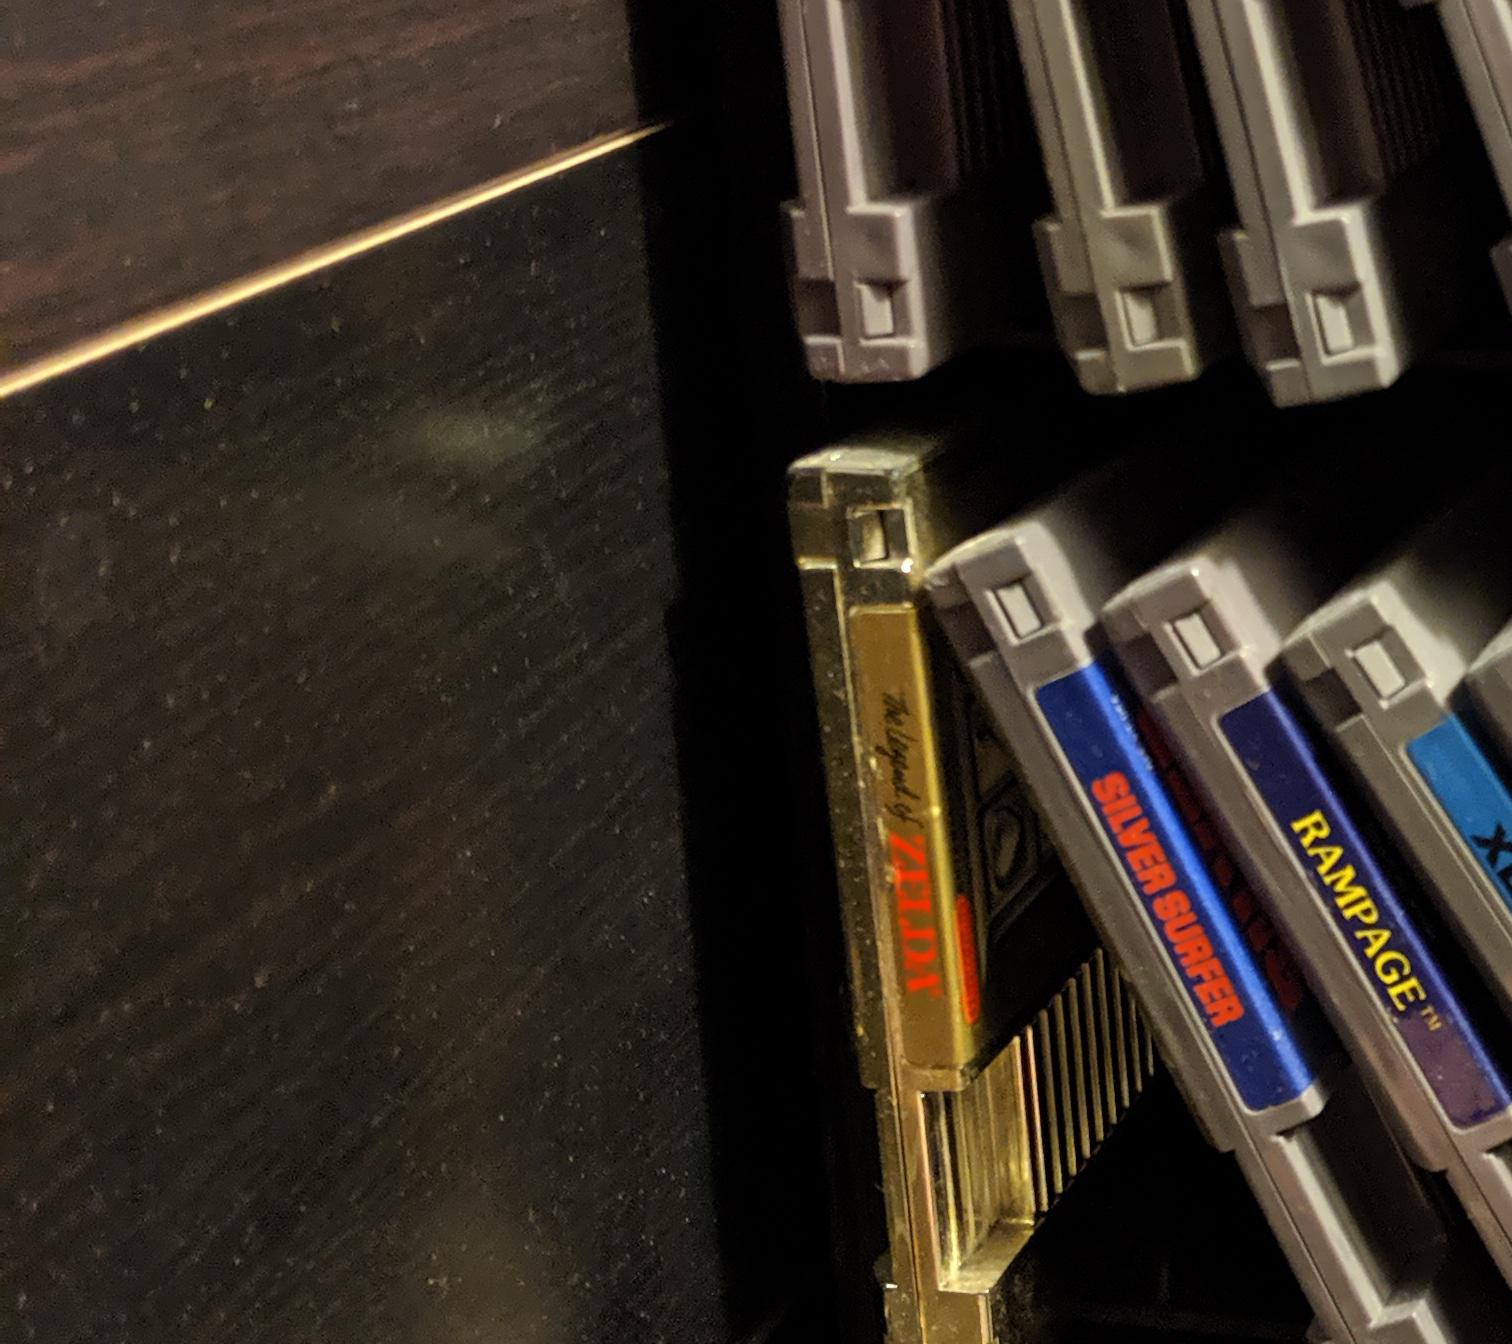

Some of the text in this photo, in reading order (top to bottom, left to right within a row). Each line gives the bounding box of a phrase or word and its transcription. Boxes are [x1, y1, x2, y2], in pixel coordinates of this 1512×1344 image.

[889, 833, 940, 993] ZELDA
[1092, 771, 1177, 895] SILVER
[1153, 892, 1245, 1028] SURFER
[1291, 810, 1426, 1010] RAMPAGE
